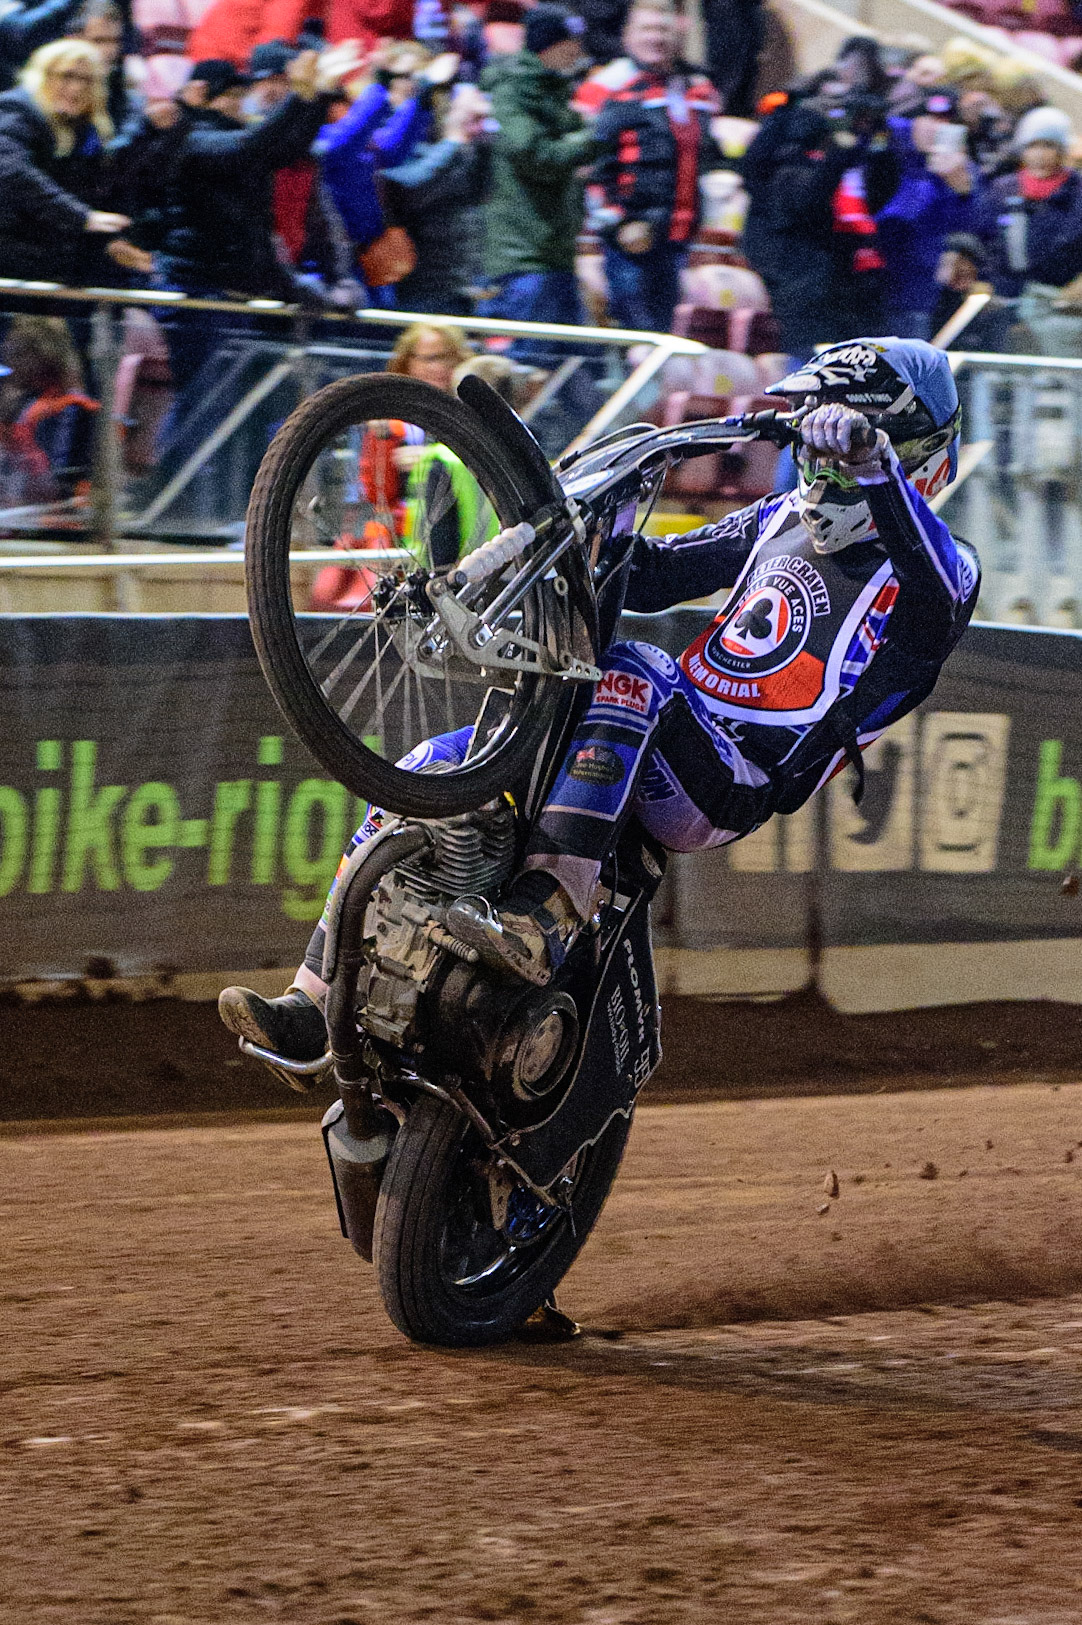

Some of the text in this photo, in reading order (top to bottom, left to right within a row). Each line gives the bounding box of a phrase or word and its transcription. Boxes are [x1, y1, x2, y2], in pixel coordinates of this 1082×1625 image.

[773, 577, 796, 596] VUE
[790, 598, 804, 633] ACES
[787, 557, 831, 617] CRAVEN
[597, 673, 649, 704] NGK
[688, 652, 761, 698] MEMORIAL
[596, 695, 645, 712] SPARK PLUGS
